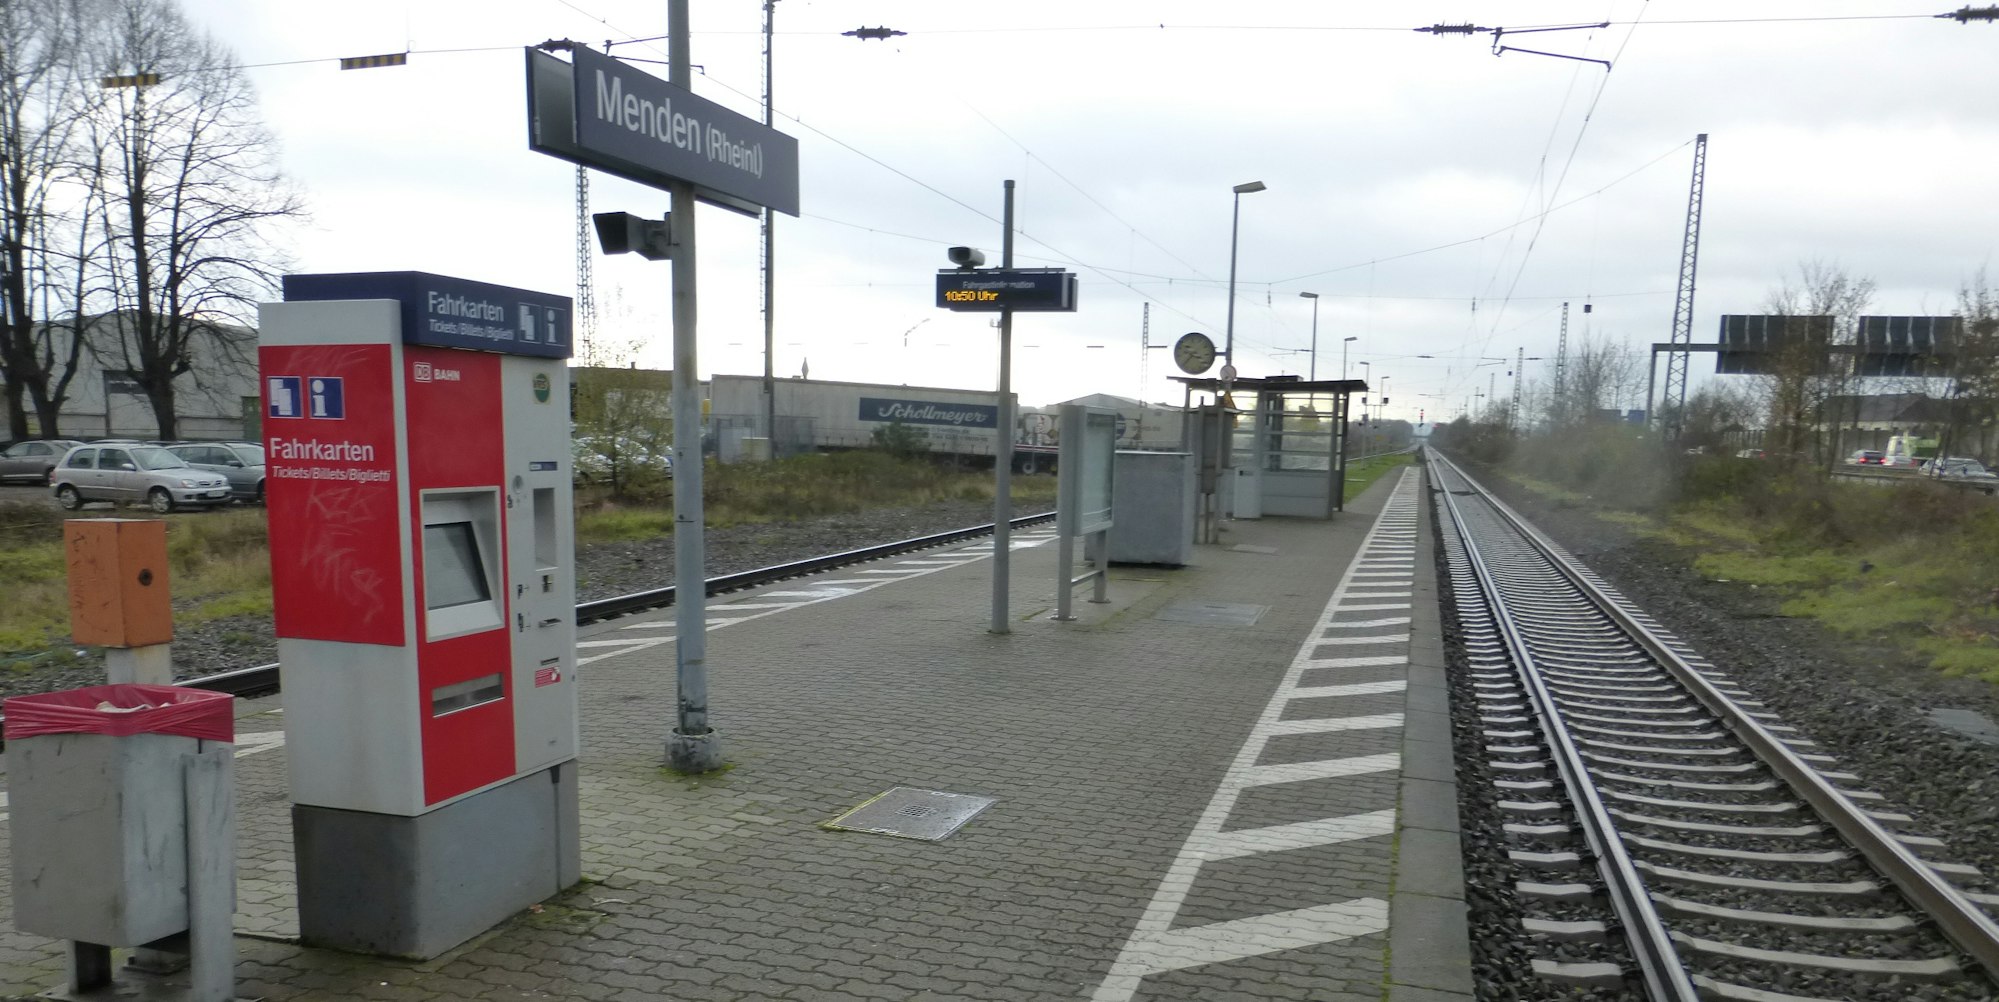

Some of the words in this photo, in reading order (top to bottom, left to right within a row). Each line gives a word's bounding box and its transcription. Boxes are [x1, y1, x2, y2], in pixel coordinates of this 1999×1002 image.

[596, 69, 701, 154] Menden
[705, 122, 763, 179] (Rheinl)
[427, 290, 504, 323] Fahrkarten
[945, 291, 976, 302] 10:50
[978, 291, 999, 301] Uhr
[433, 368, 461, 382] BAHN
[878, 402, 989, 425] Schollmeyer
[269, 437, 374, 462] Fahrkarten
